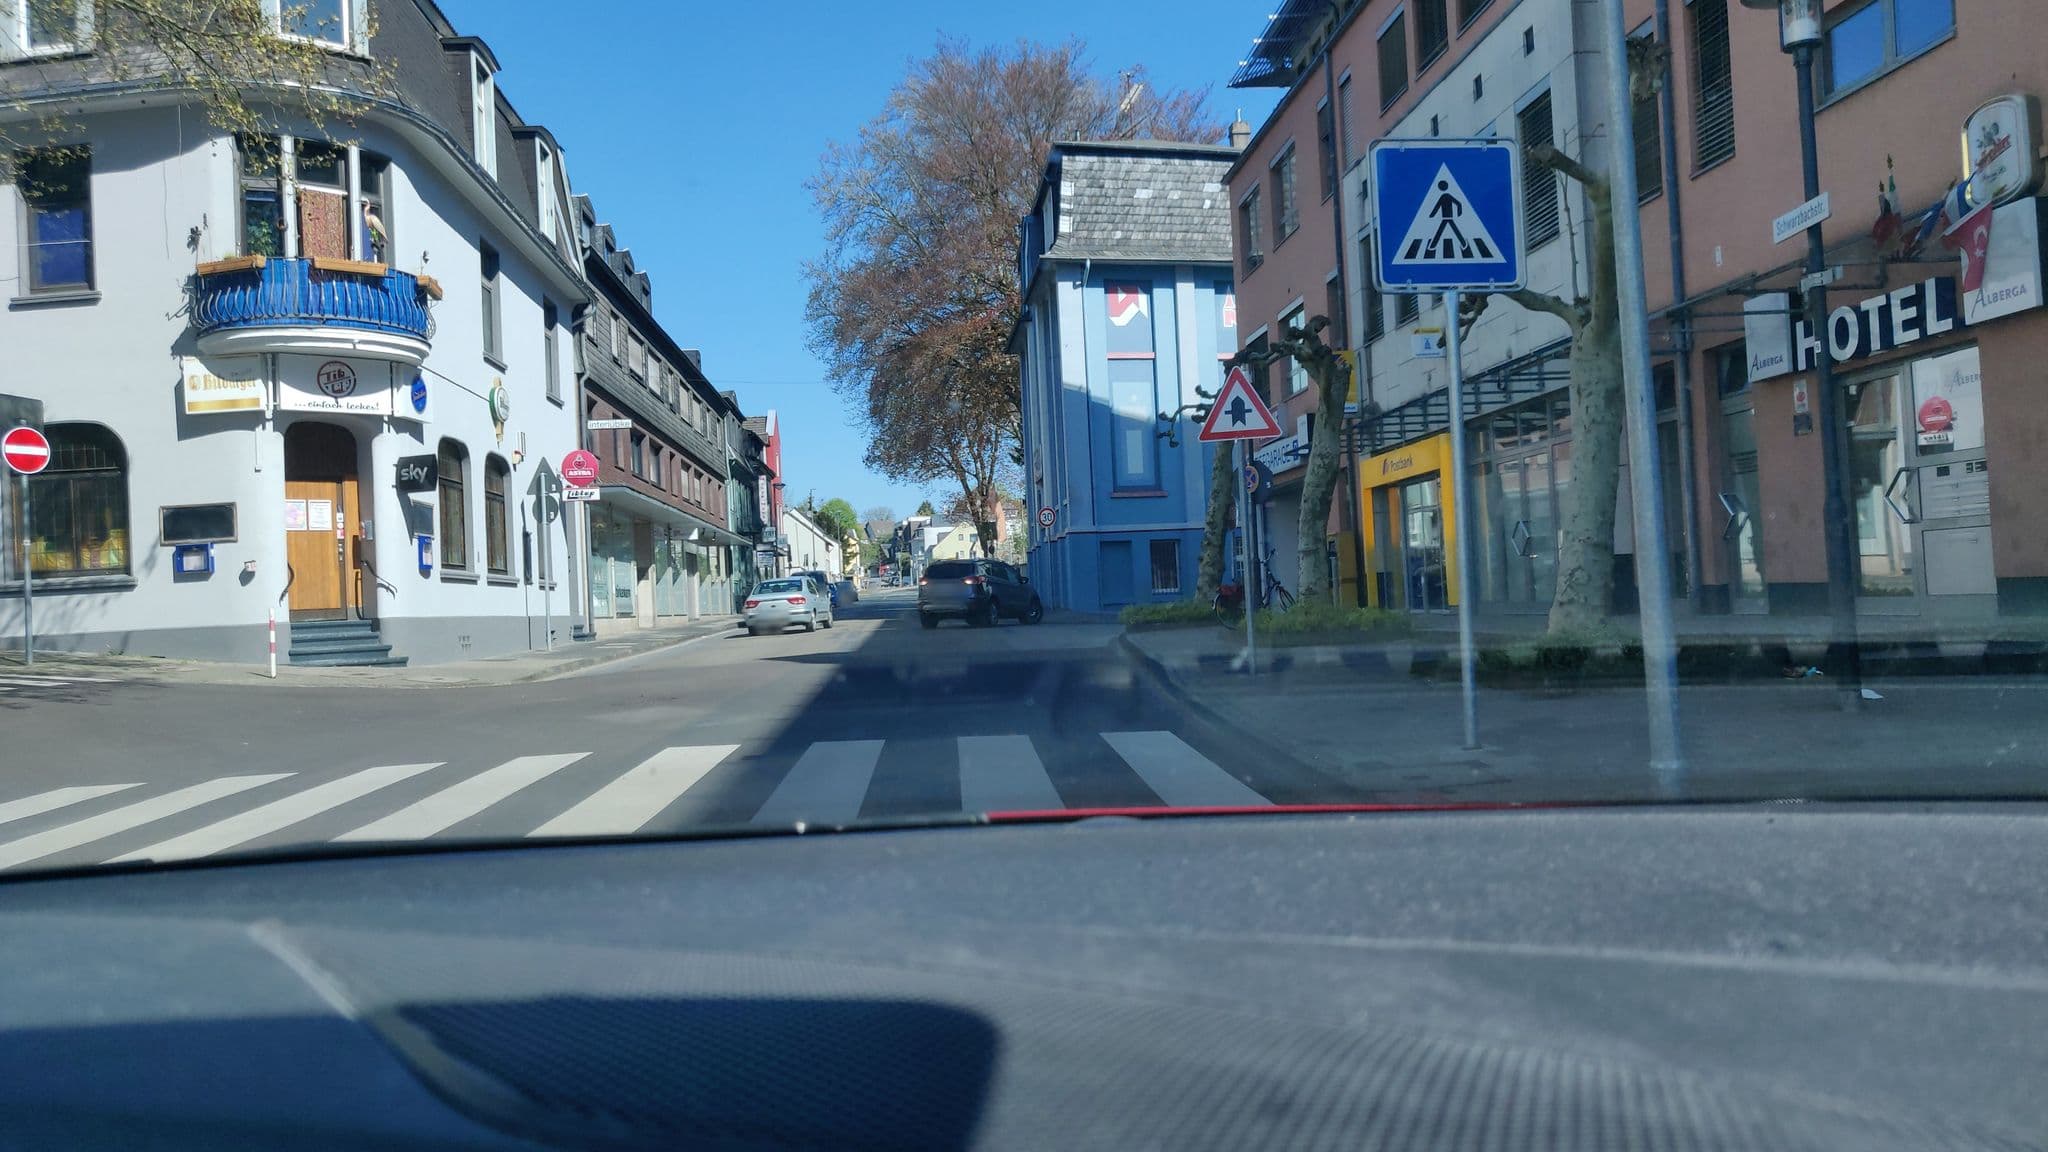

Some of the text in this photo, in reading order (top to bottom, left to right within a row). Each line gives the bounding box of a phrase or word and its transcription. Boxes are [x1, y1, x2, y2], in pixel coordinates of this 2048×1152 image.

[1776, 200, 1825, 236] Schwarzbachstr.
[1971, 284, 2027, 317] ALBERGA
[1795, 278, 1952, 371] HOTEL
[1750, 353, 1784, 376] ALBERGA
[401, 464, 427, 483] sky
[1042, 512, 1053, 522] 30
